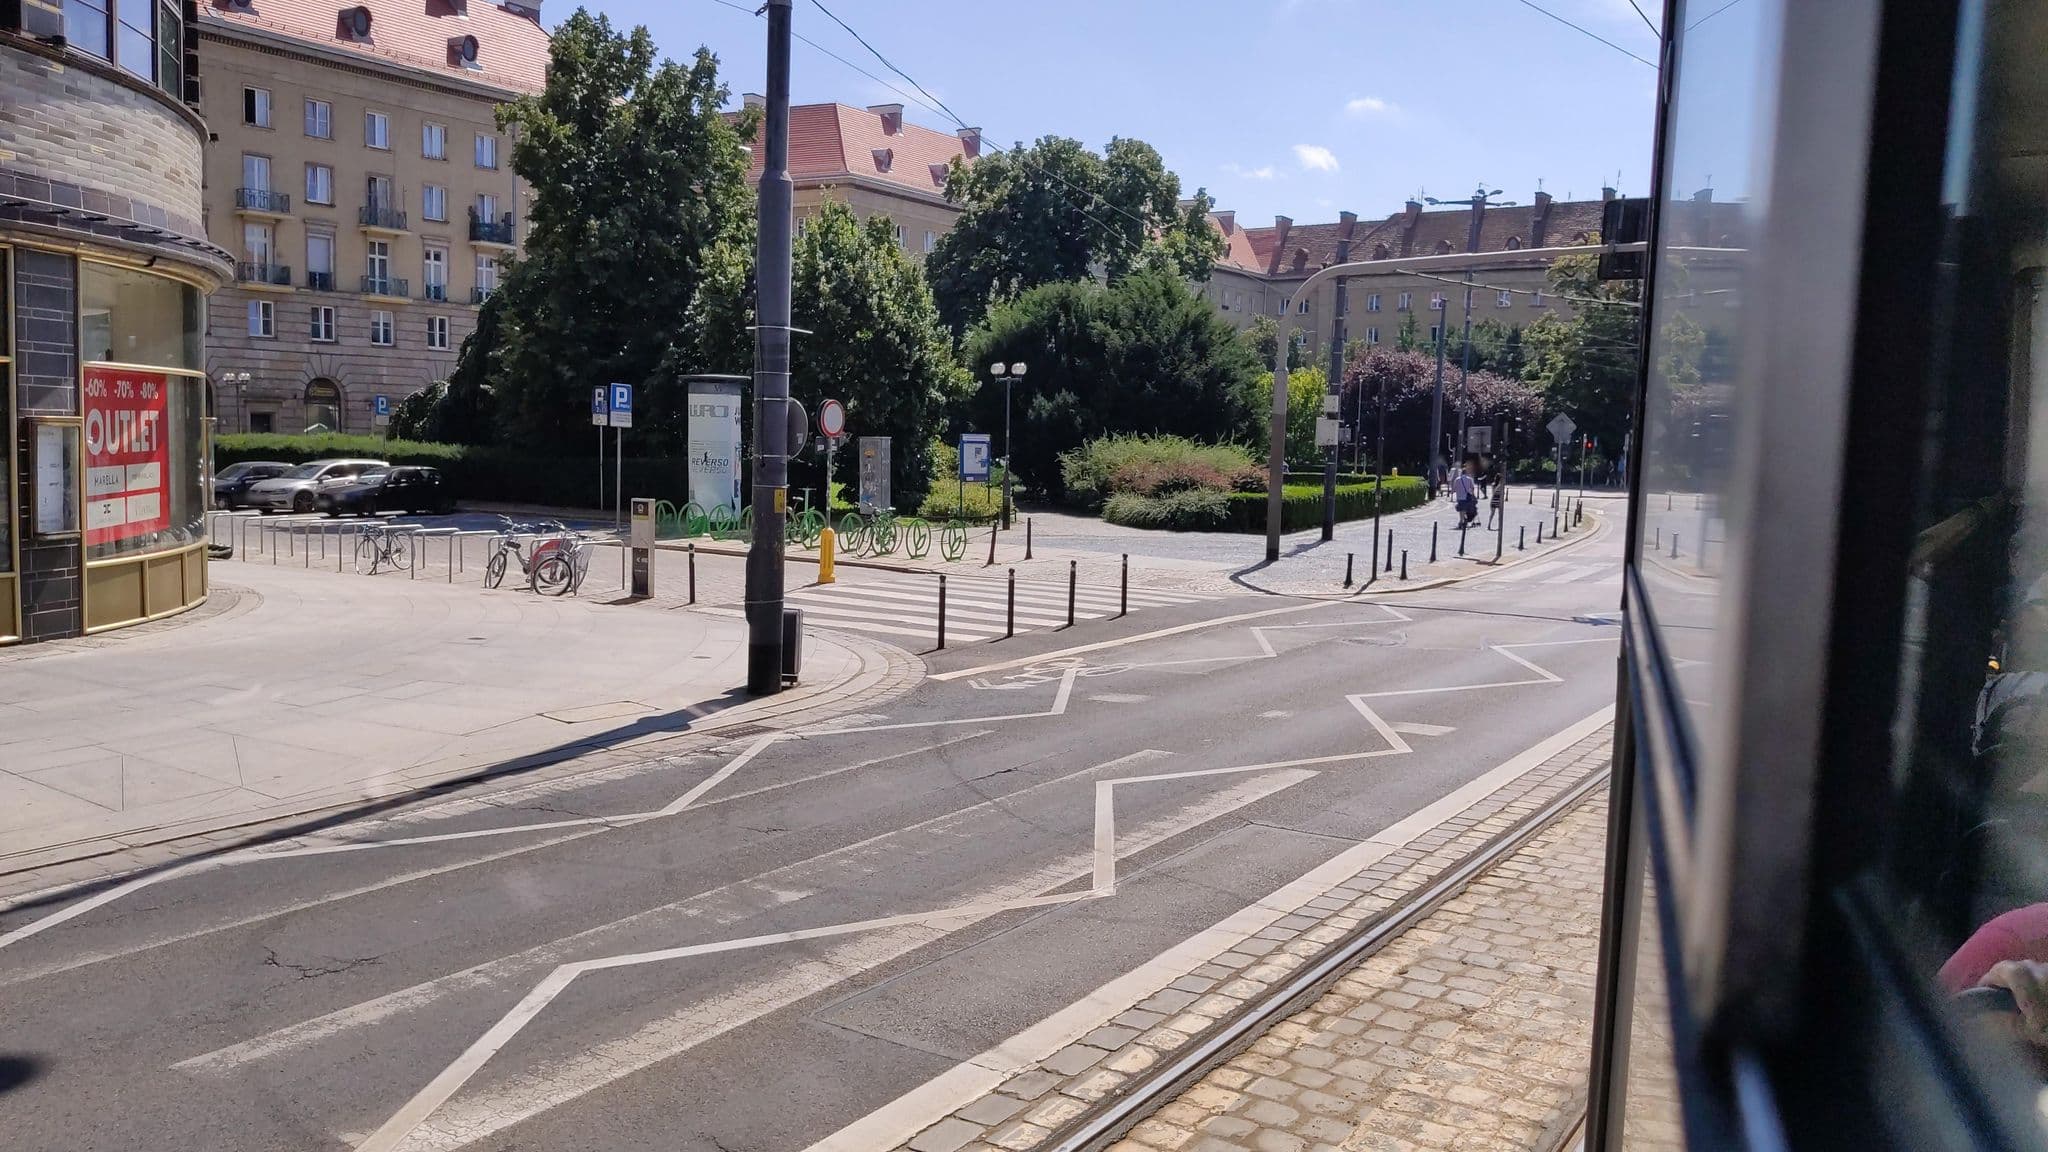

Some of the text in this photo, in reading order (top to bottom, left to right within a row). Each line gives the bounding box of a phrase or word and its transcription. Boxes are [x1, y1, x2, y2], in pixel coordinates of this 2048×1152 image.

[85, 378, 159, 400] -60% -70% -80%
[615, 386, 628, 408] P
[378, 396, 387, 413] P
[86, 408, 159, 456] OUTLET
[691, 457, 729, 467] REVERSO
[94, 474, 119, 487] MARELLA
